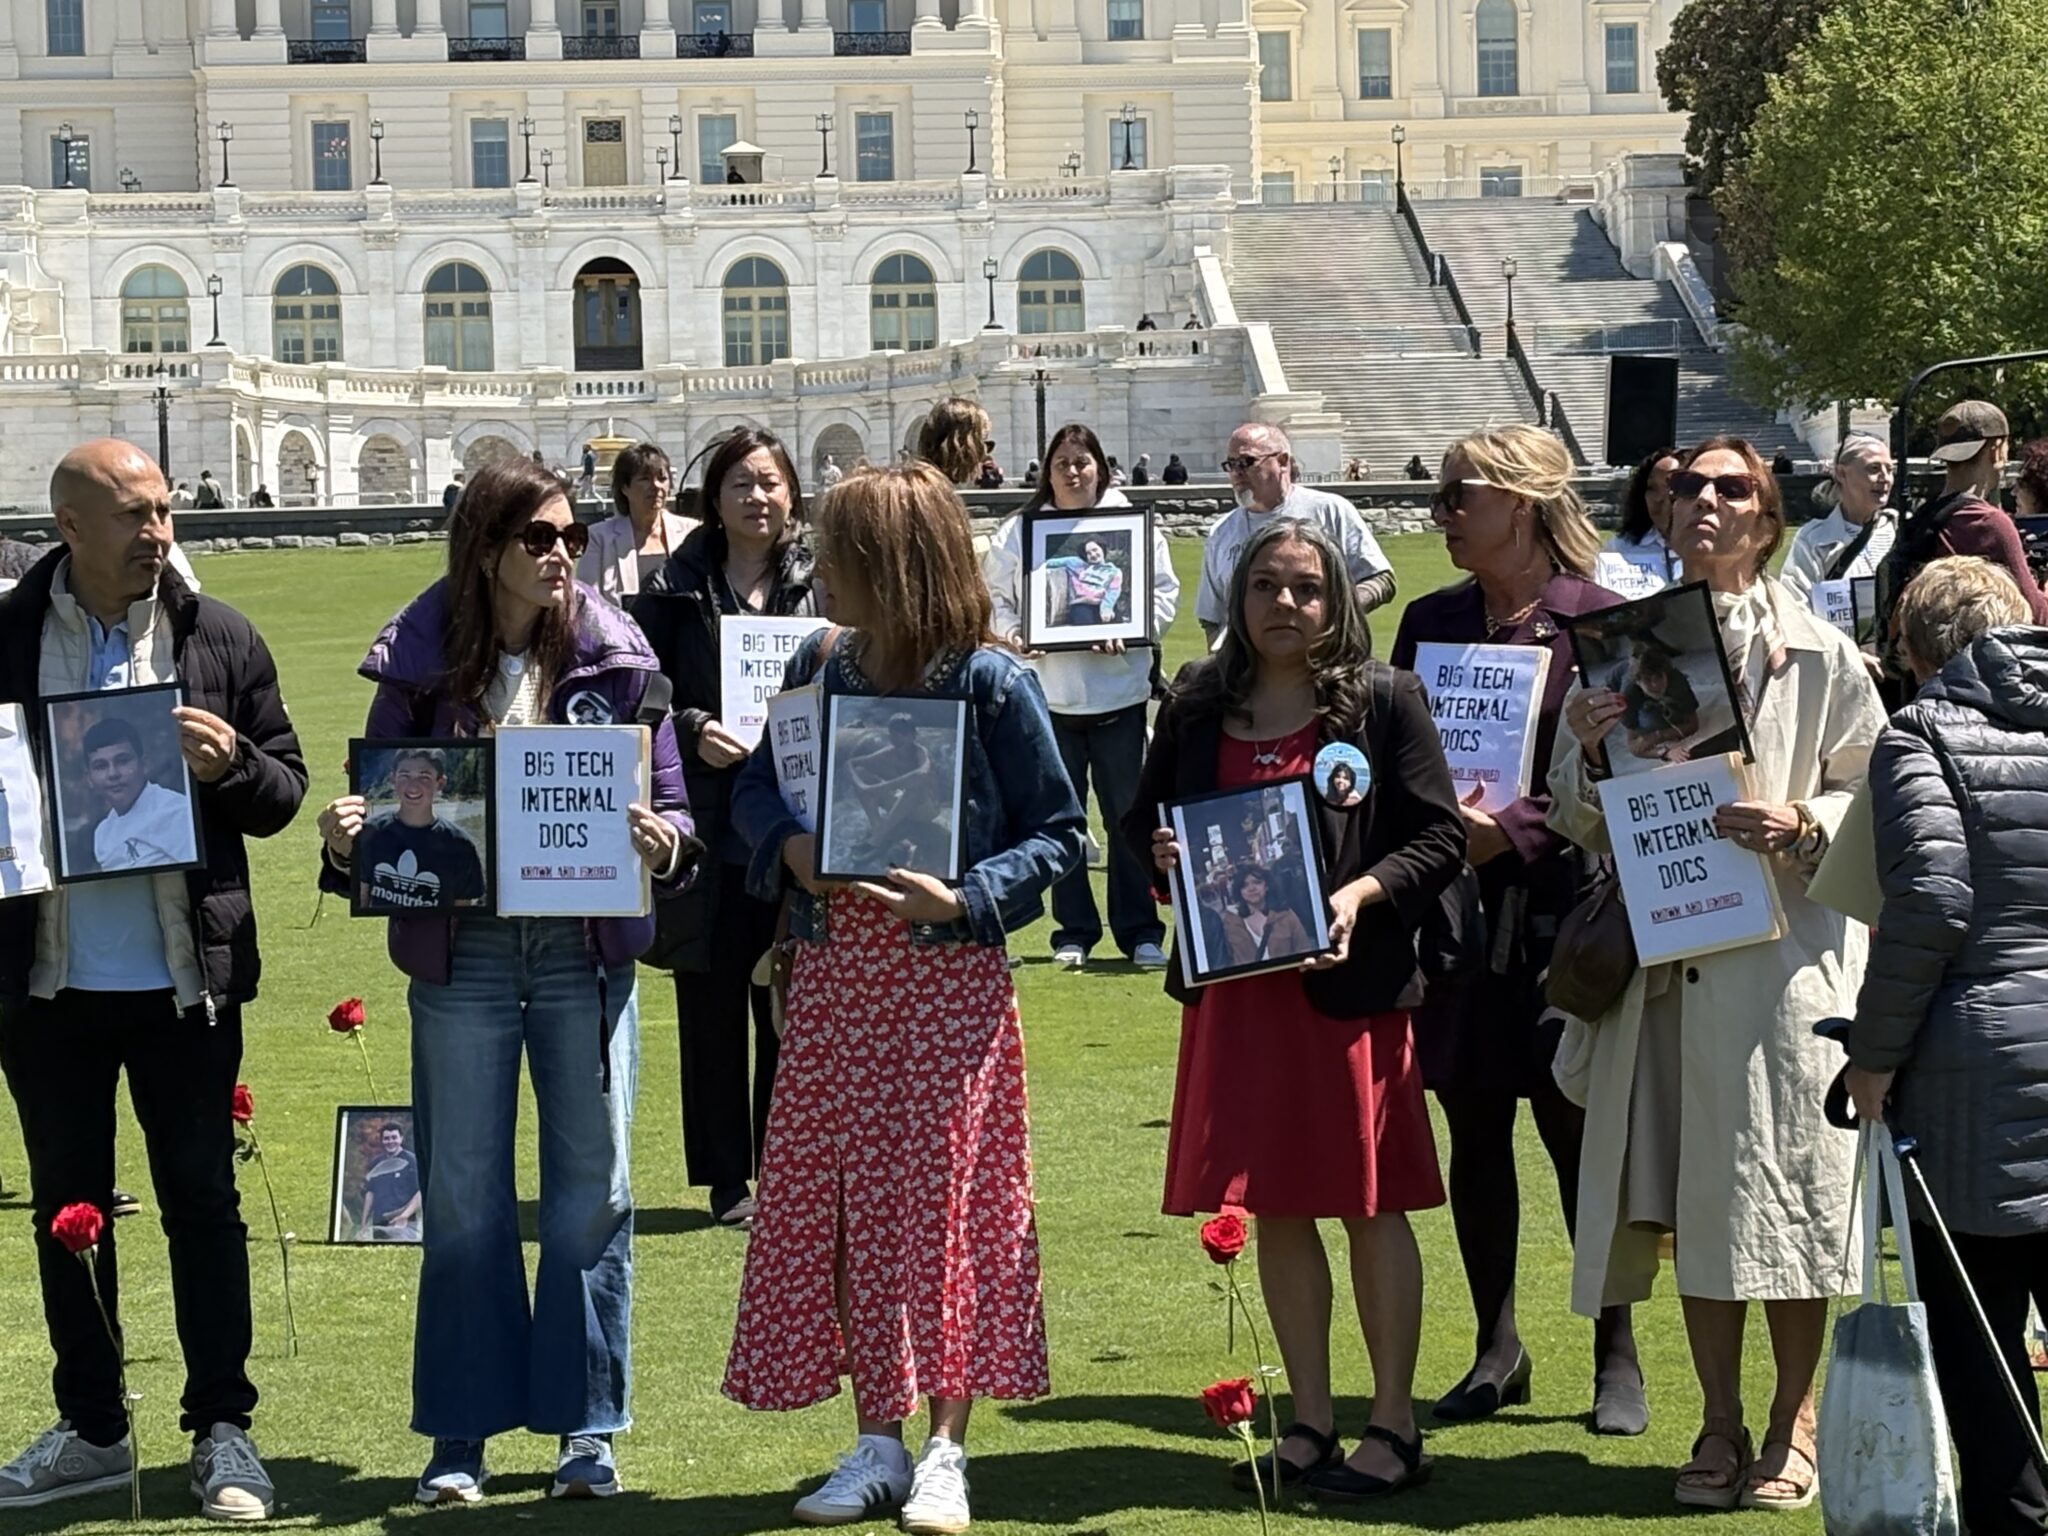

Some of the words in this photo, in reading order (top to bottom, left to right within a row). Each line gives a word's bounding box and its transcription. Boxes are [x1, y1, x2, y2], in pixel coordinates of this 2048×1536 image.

[742, 633, 766, 653] BIG
[772, 634, 806, 653] TEC
[1436, 665, 1464, 688] BIG
[1472, 666, 1515, 690] TECH
[1430, 695, 1511, 721] INTERNAL
[1440, 728, 1482, 752] DOCS
[524, 751, 555, 777] BIG
[564, 751, 614, 777] TECH
[521, 786, 617, 813] INTERNAL
[1627, 793, 1660, 823] BIG
[1663, 781, 1715, 815] TECH
[539, 822, 588, 849] DOCS
[558, 866, 576, 880] AND
[579, 866, 617, 880] IGNORED
[1657, 855, 1709, 890] DOCS
